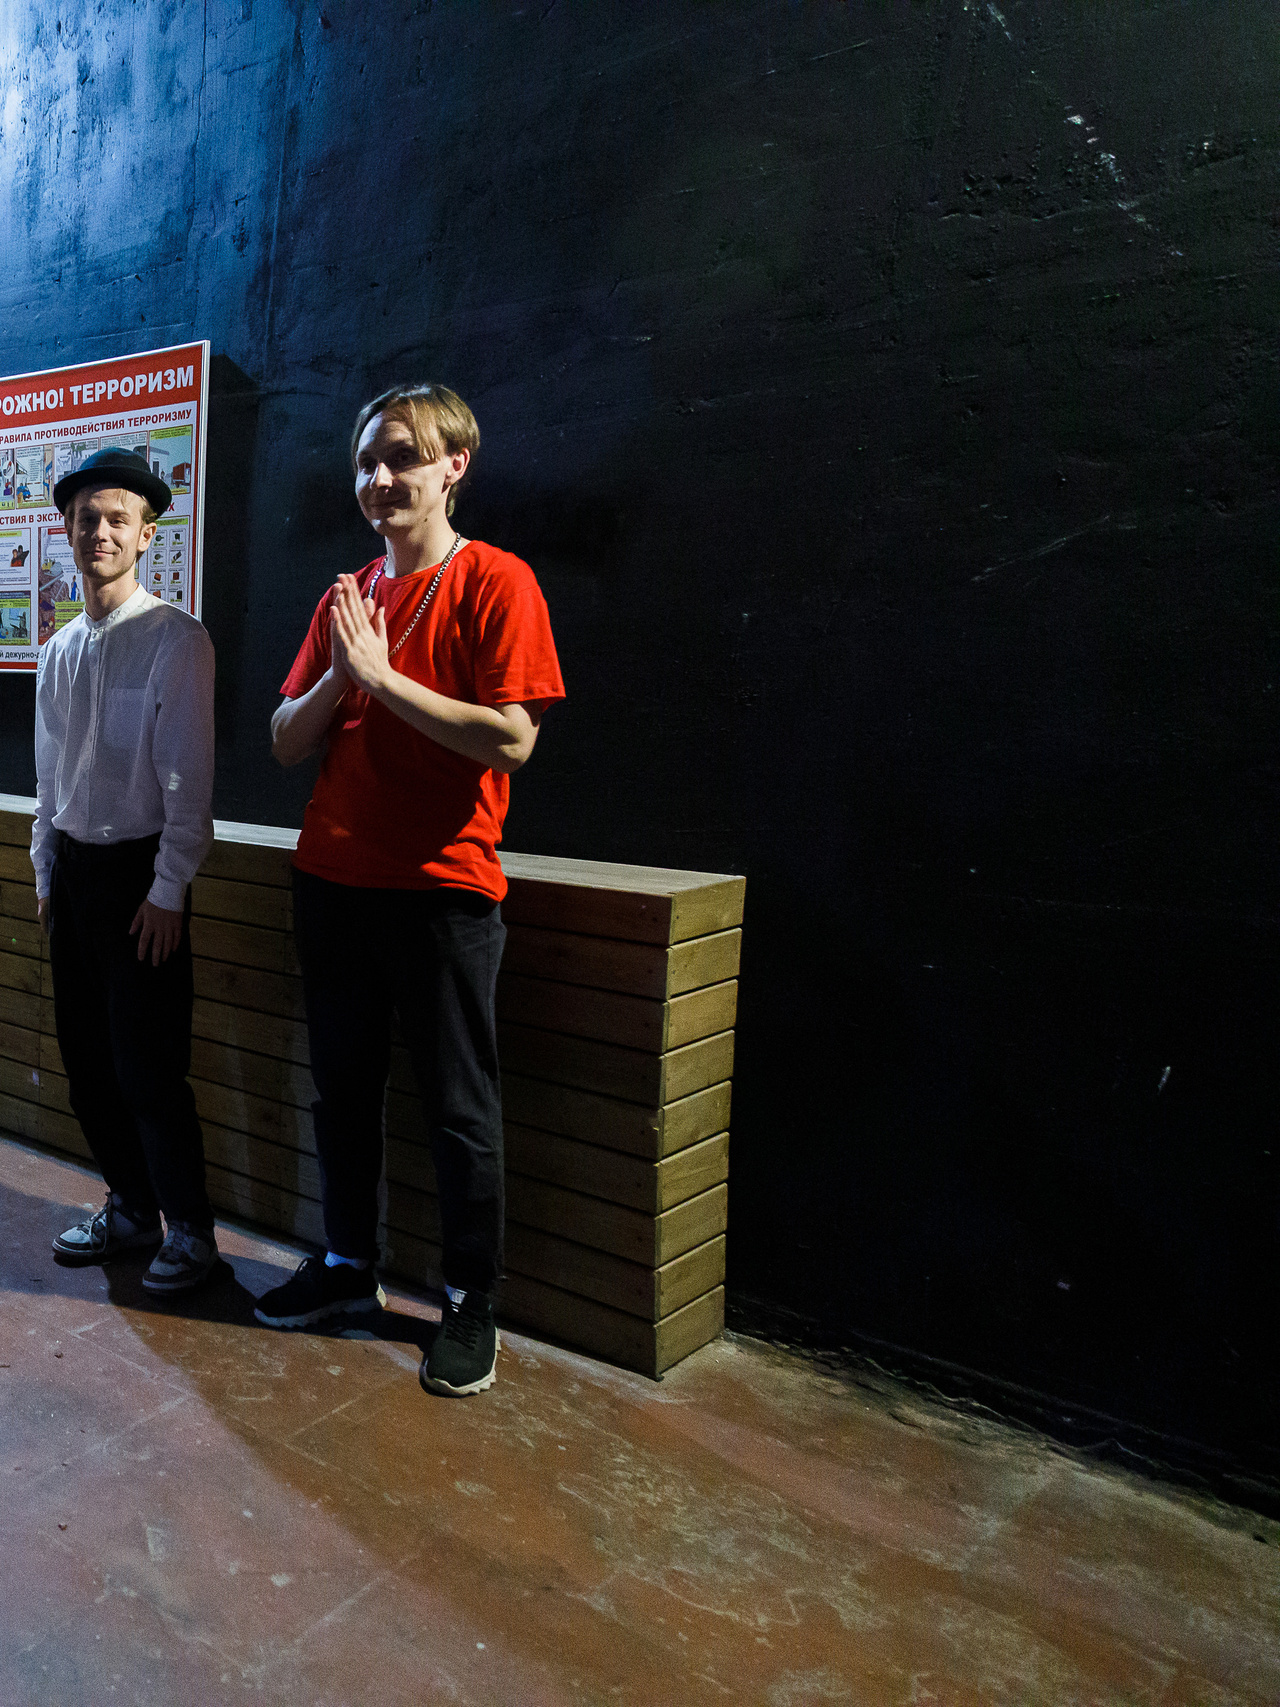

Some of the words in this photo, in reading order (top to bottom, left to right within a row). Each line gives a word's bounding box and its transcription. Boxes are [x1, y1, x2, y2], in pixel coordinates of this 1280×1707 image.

[69, 365, 194, 406] ТЕРРОРИЗМ
[34, 420, 125, 440] ПРОТИВОДЕЙСТВИЯ
[127, 409, 192, 428] ТЕРРОРИЗМУ
[29, 514, 35, 523] В
[36, 512, 63, 522] ЭКСТР
